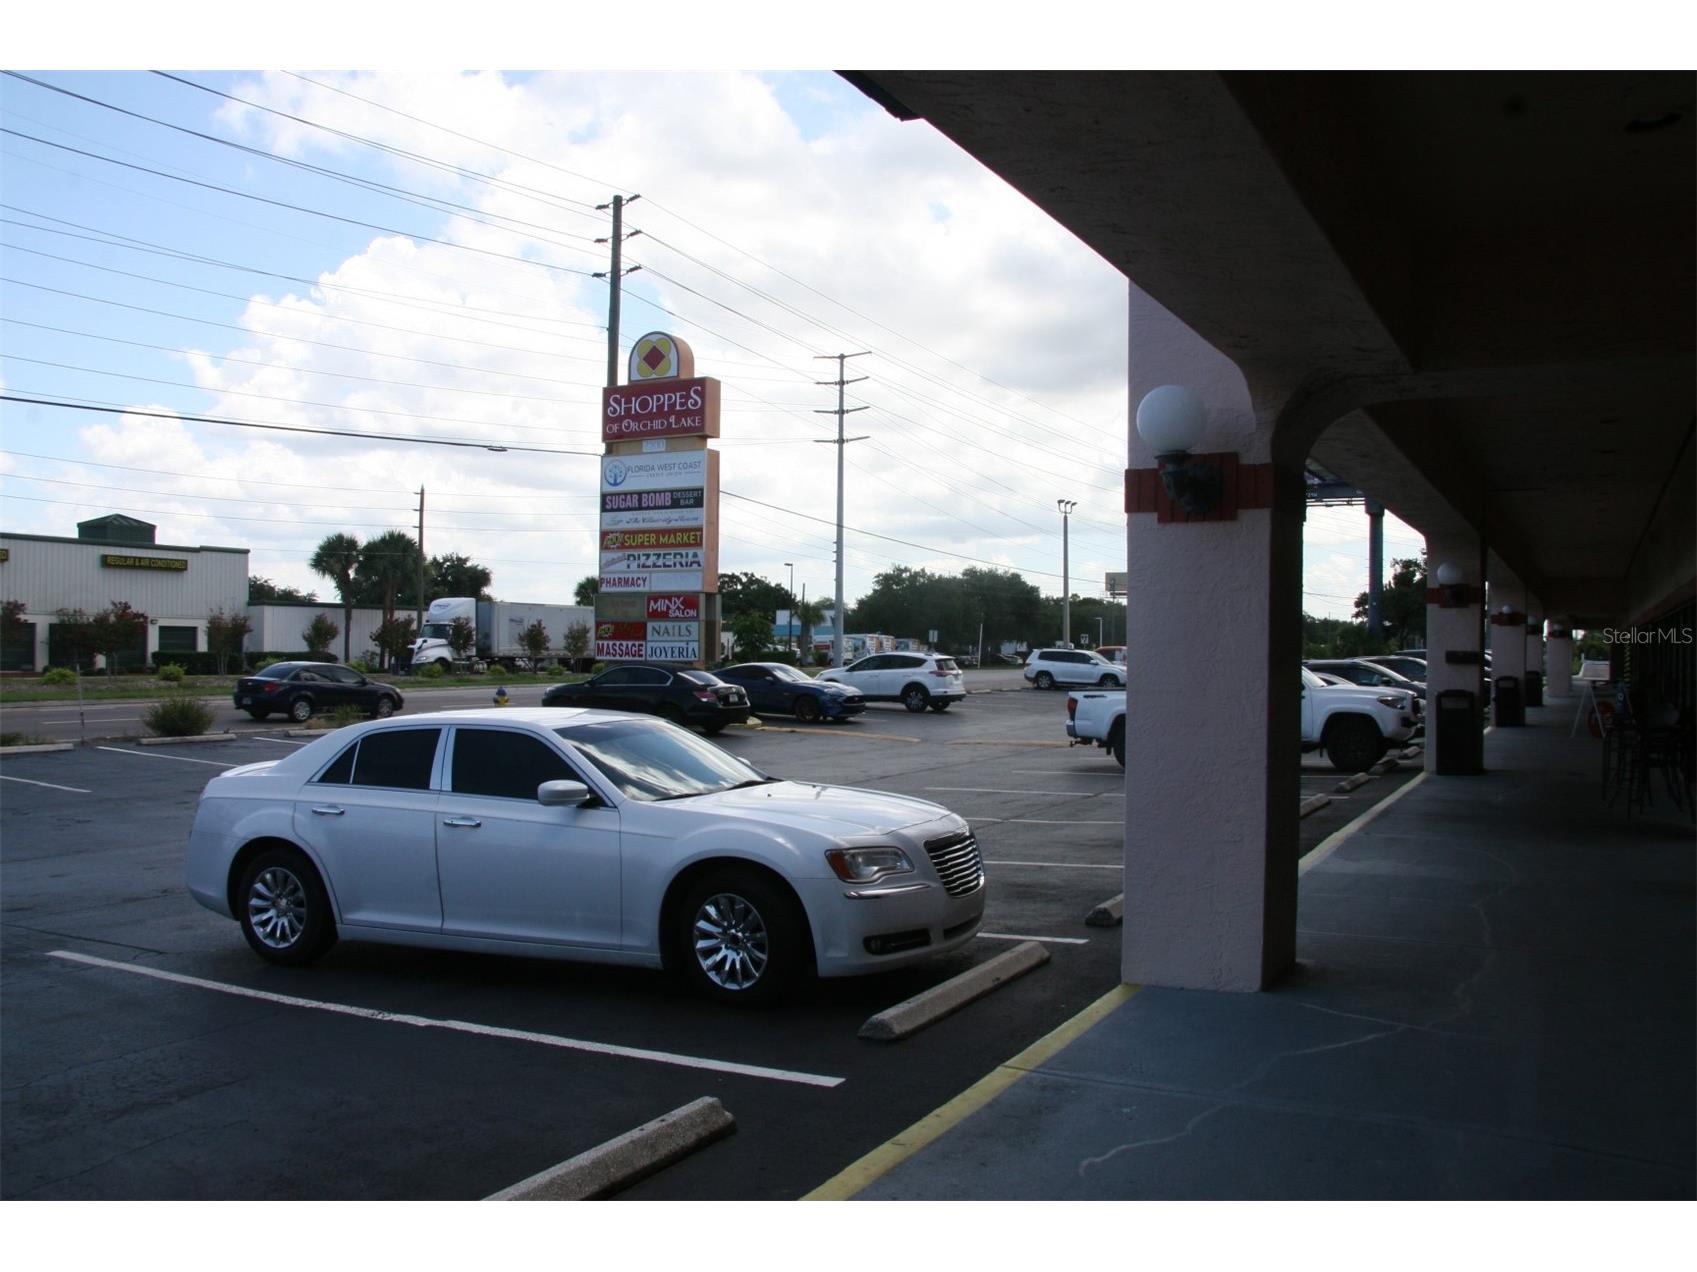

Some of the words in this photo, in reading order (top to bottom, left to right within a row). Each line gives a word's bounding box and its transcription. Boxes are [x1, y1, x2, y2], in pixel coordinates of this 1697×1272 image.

[608, 386, 702, 417] SHOPPES
[606, 423, 620, 434] OF
[622, 419, 667, 432] ORCHID
[669, 415, 702, 428] LAKE
[627, 464, 656, 473] FLORIDA
[657, 463, 676, 472] WEST
[678, 461, 702, 470] COAST
[606, 494, 639, 509] SUGAR
[642, 492, 671, 507] BOMB
[673, 490, 702, 499] DESSERT
[680, 497, 694, 506] BAR
[624, 533, 656, 546] SUPER
[659, 531, 702, 544] MARKET
[626, 552, 702, 569] PIZZERIA
[600, 576, 647, 588] PHARMACY
[649, 597, 684, 612] MINX
[668, 609, 697, 617] SALON
[651, 624, 692, 637] NAILS
[596, 643, 644, 657] MASSAGE
